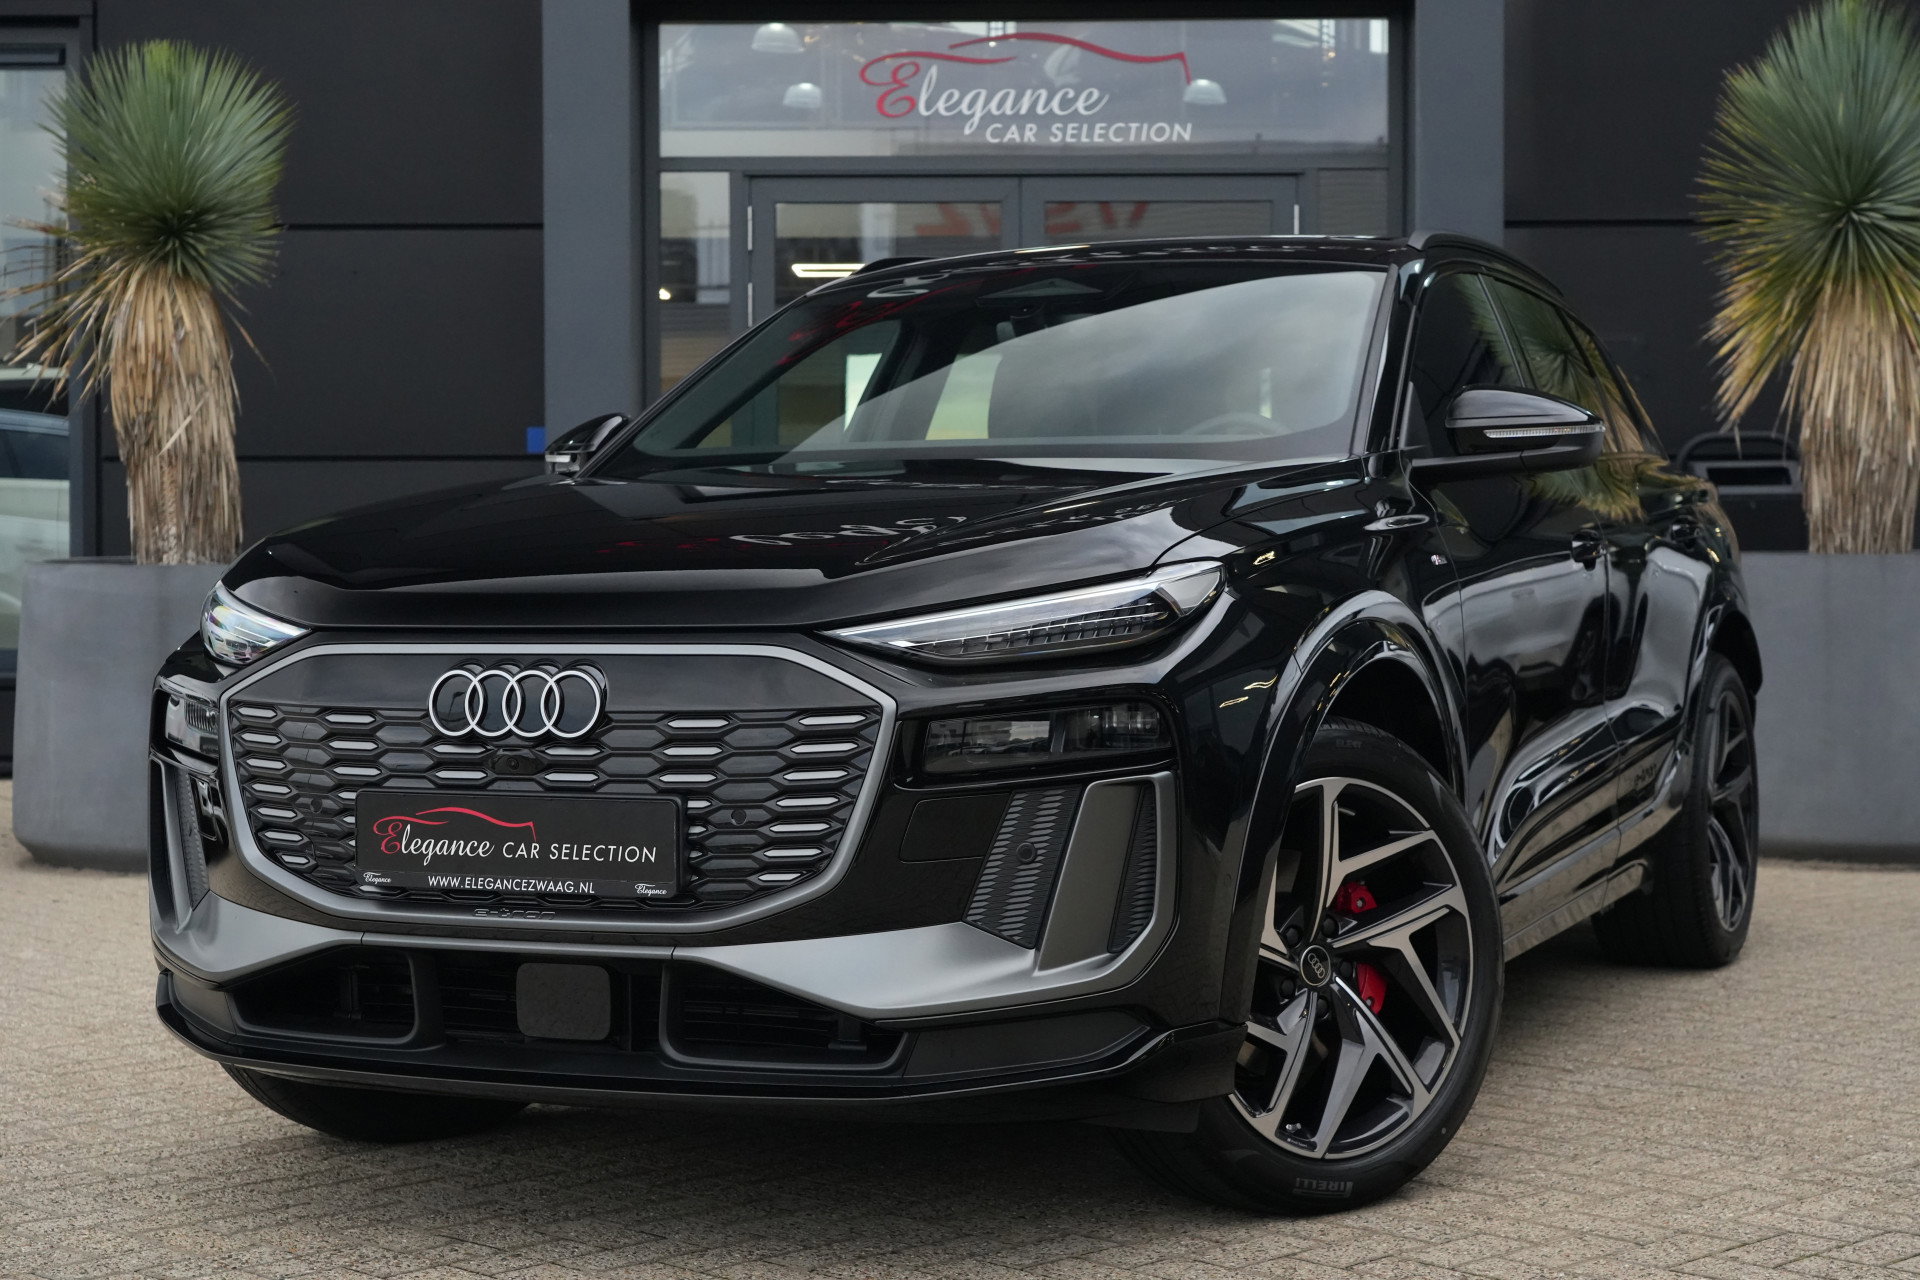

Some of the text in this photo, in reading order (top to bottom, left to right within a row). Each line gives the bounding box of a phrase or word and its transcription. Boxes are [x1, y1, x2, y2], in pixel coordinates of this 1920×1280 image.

[860, 51, 1109, 136] Elegance
[985, 122, 1193, 144] CAR SELECTION
[373, 816, 657, 866] Elegance CAR SELECTION
[363, 871, 391, 884] Elegance
[428, 875, 595, 894] WWW.ELEGANCEZWAAG.NL
[634, 883, 668, 897] Elegance
[1294, 1178, 1353, 1198] PIRELLI
